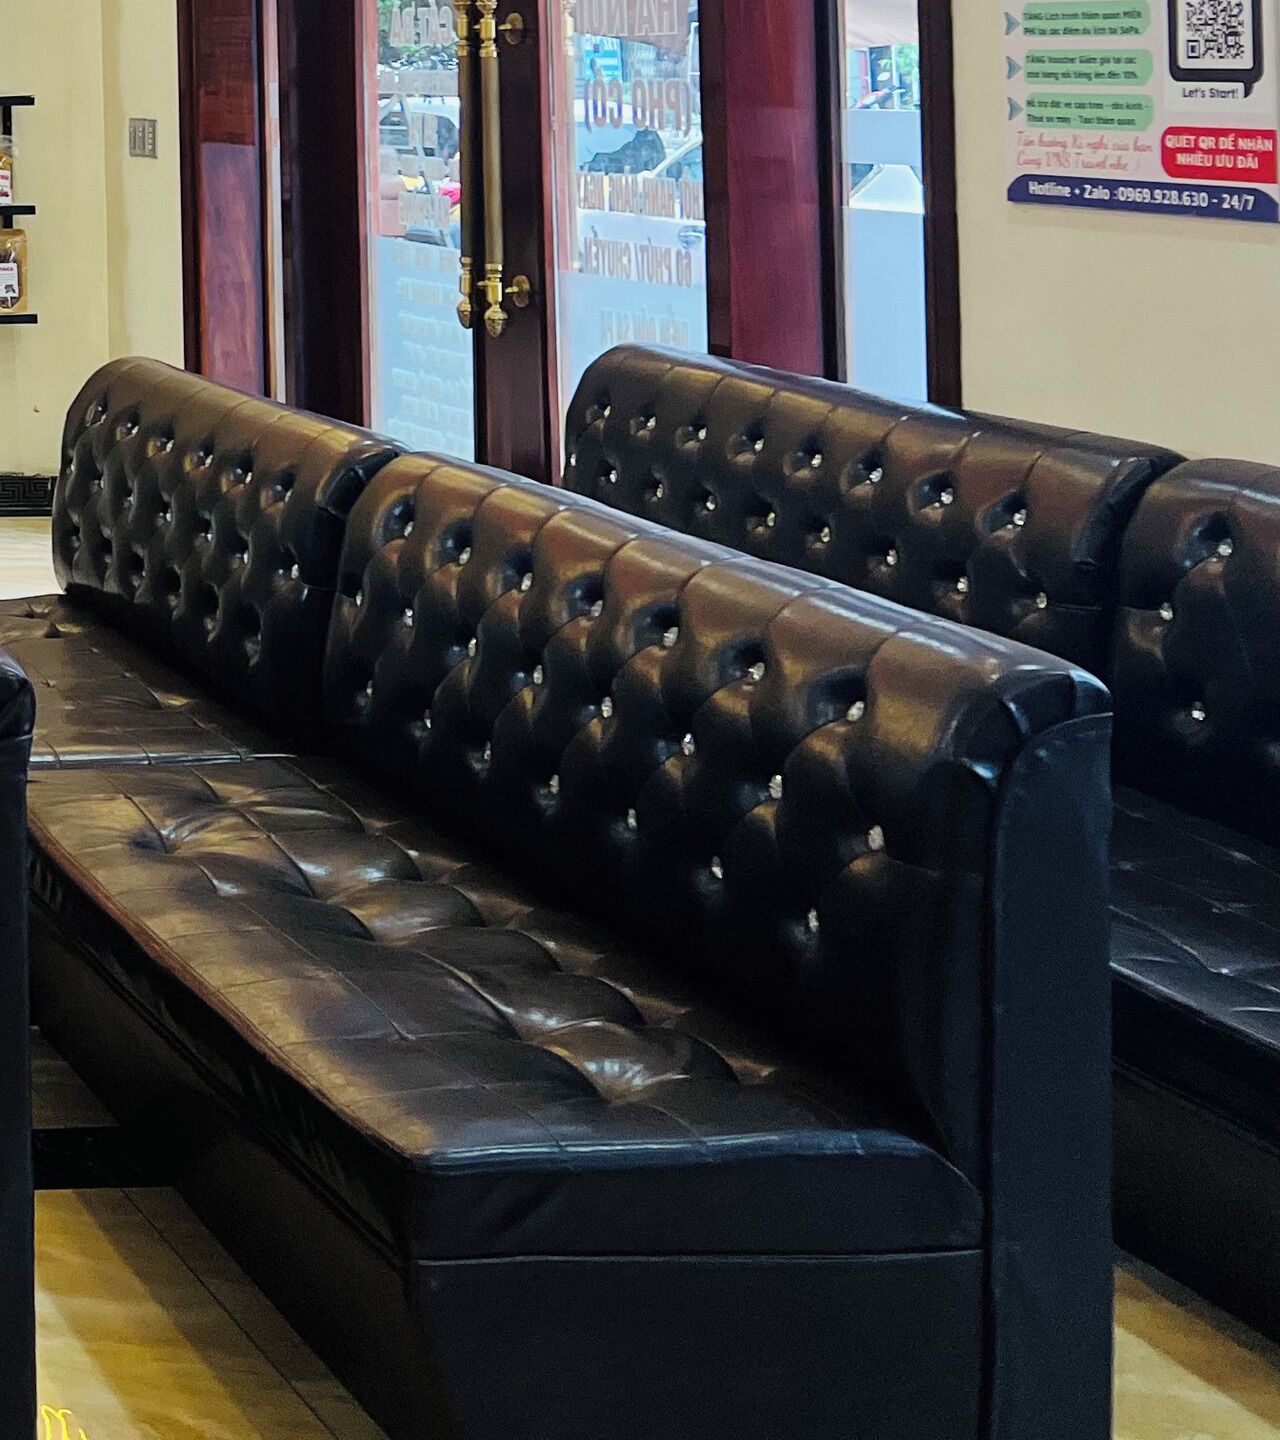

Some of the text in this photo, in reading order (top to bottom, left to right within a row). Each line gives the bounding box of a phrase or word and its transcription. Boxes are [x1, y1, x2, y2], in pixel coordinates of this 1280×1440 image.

[1182, 88, 1206, 98] Let's
[1199, 136, 1216, 150] QR
[1028, 181, 1071, 197] Hotline
[1083, 184, 1110, 200] Zalo
[1221, 193, 1255, 211] 24/7
